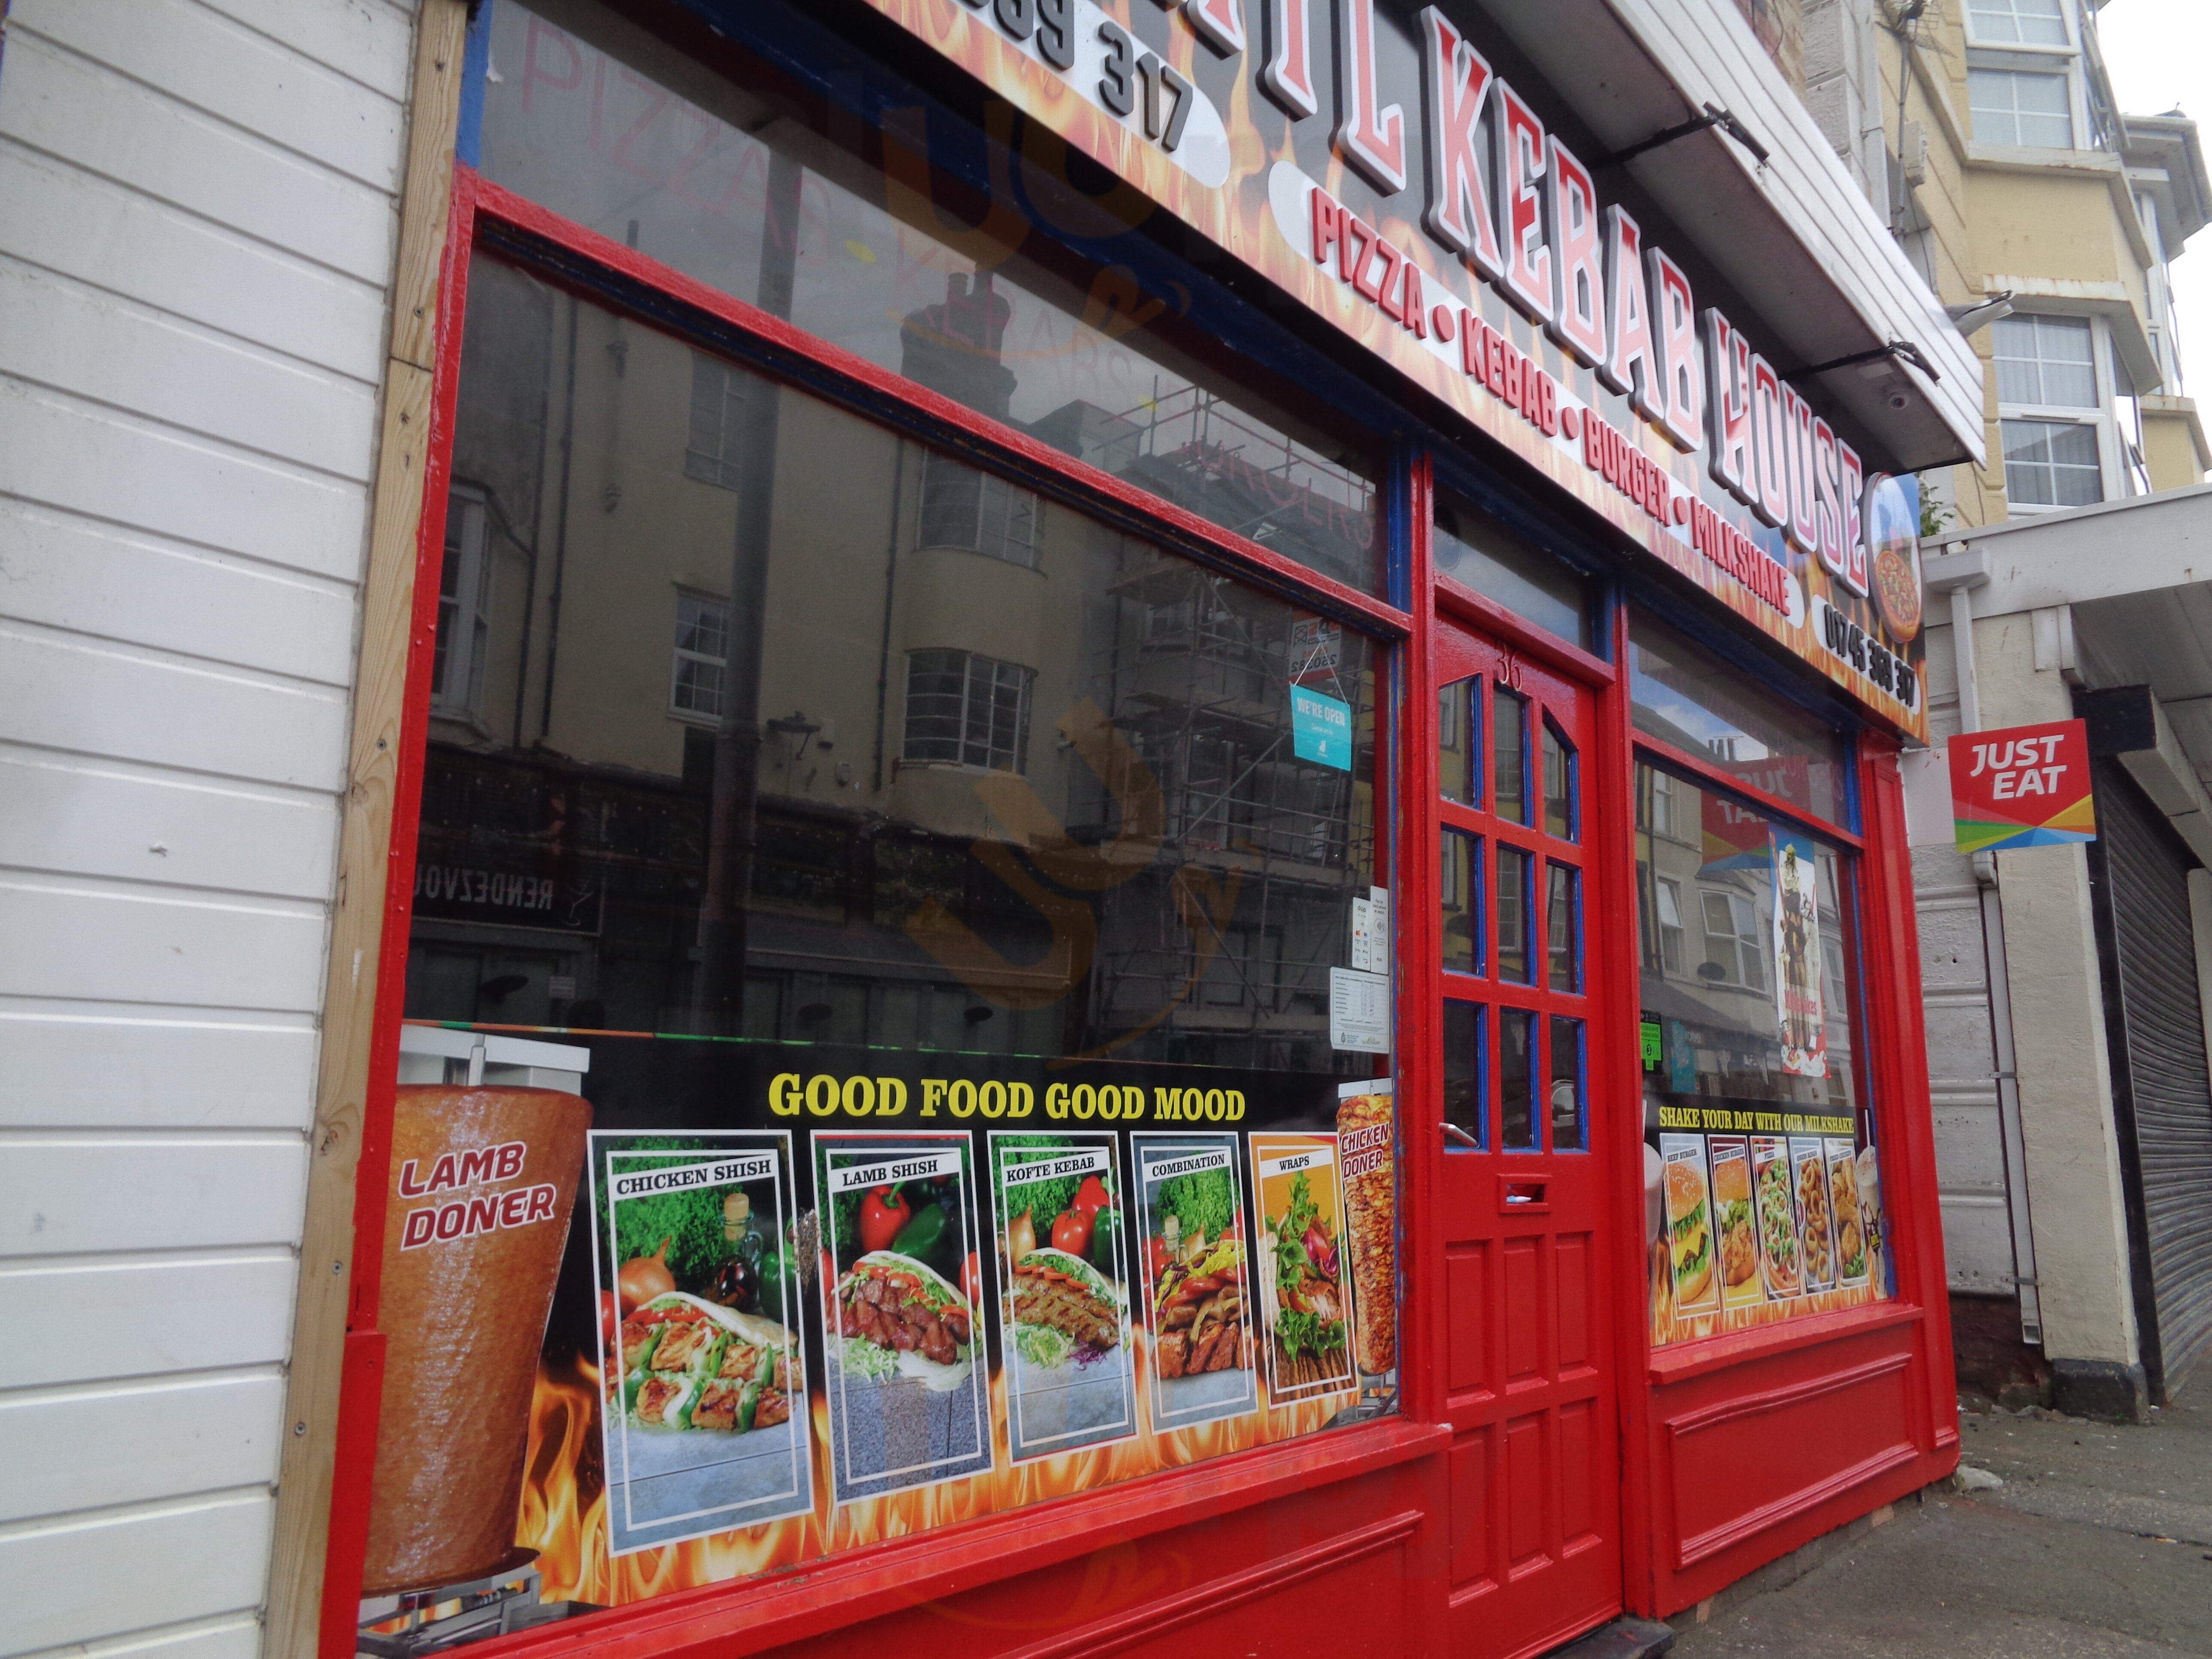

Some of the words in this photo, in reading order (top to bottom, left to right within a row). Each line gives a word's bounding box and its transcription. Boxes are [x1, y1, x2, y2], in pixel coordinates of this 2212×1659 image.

[1098, 21, 1193, 152] 317
[1421, 5, 1702, 452] KEBAB
[1705, 307, 1869, 598] HOUSE
[1311, 187, 1426, 339] PIZZA
[1460, 308, 1557, 437] KEBAB
[1581, 407, 1671, 527] BURGER
[1690, 495, 1790, 617] MILKSHAKE
[1297, 698, 1323, 720] WE'RE
[1325, 705, 1346, 726] OPEN
[1970, 734, 2065, 777] JUST
[1993, 765, 2067, 799] EAT
[769, 1073, 907, 1117] GOOD
[920, 1078, 1033, 1118] FOOD
[1045, 1082, 1145, 1120] GOOD
[1154, 1087, 1245, 1121] MOOD
[1659, 1106, 1700, 1127] SHAKE
[1702, 1109, 1732, 1129] YOUR
[1734, 1111, 1753, 1130] DAY
[1755, 1112, 1782, 1130] WITH
[1784, 1114, 1803, 1131] OUR
[1805, 1115, 1854, 1134] MILKSHAKE
[1340, 1121, 1390, 1155] CHICKEN
[398, 1140, 526, 1199] LAMB
[616, 1168, 708, 1195] CHICKEN
[714, 1159, 772, 1181] SHISH
[842, 1168, 887, 1187] LAMB
[891, 1159, 939, 1180] SHISH
[1006, 1163, 1051, 1183] KOFTE
[1054, 1157, 1094, 1174] KEBAB
[1152, 1154, 1225, 1177] COMBINATION
[1279, 1155, 1310, 1171] WRAPS
[1343, 1149, 1384, 1180] DONER
[400, 1183, 556, 1252] DONER
